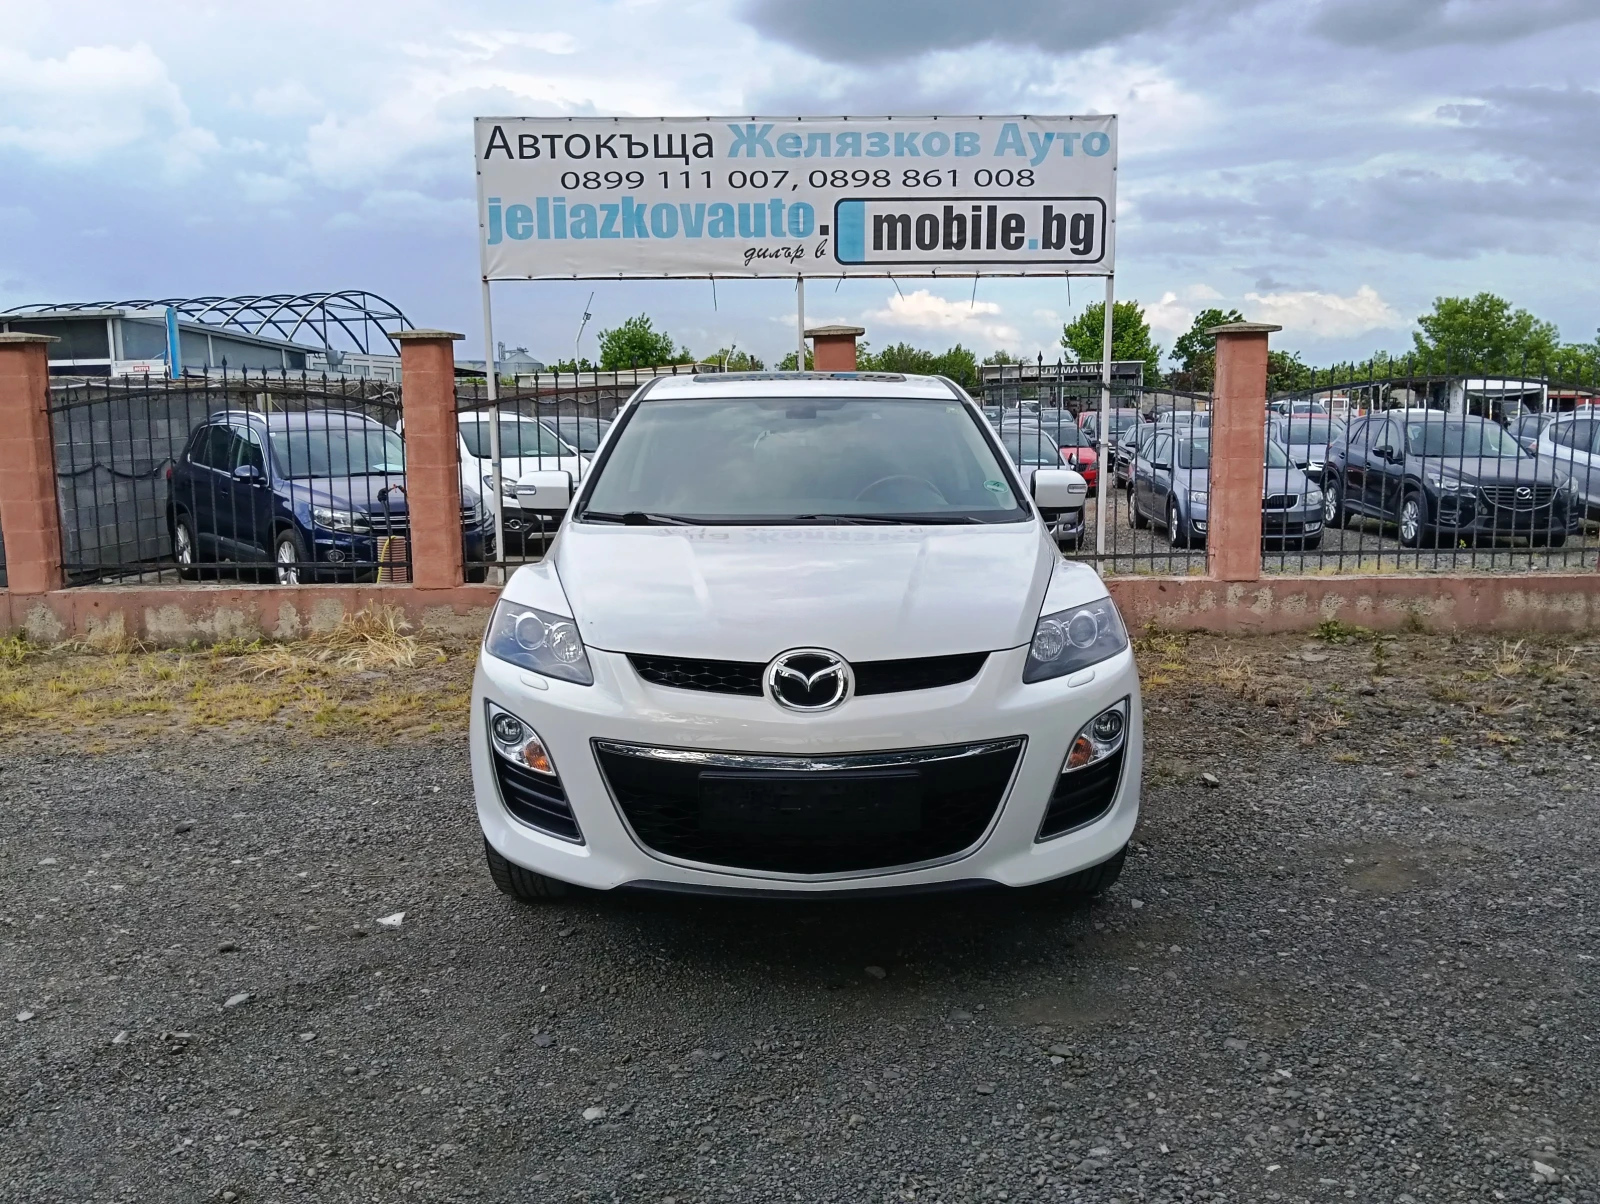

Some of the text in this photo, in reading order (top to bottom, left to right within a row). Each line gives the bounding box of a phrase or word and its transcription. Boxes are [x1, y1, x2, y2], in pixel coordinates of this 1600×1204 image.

[484, 122, 1111, 167] Автокъща Желязков Ауто
[561, 168, 1035, 191] 0899 111 007, 0898 861 008
[872, 205, 1095, 255] mobile.bg
[744, 244, 805, 266] дилър
